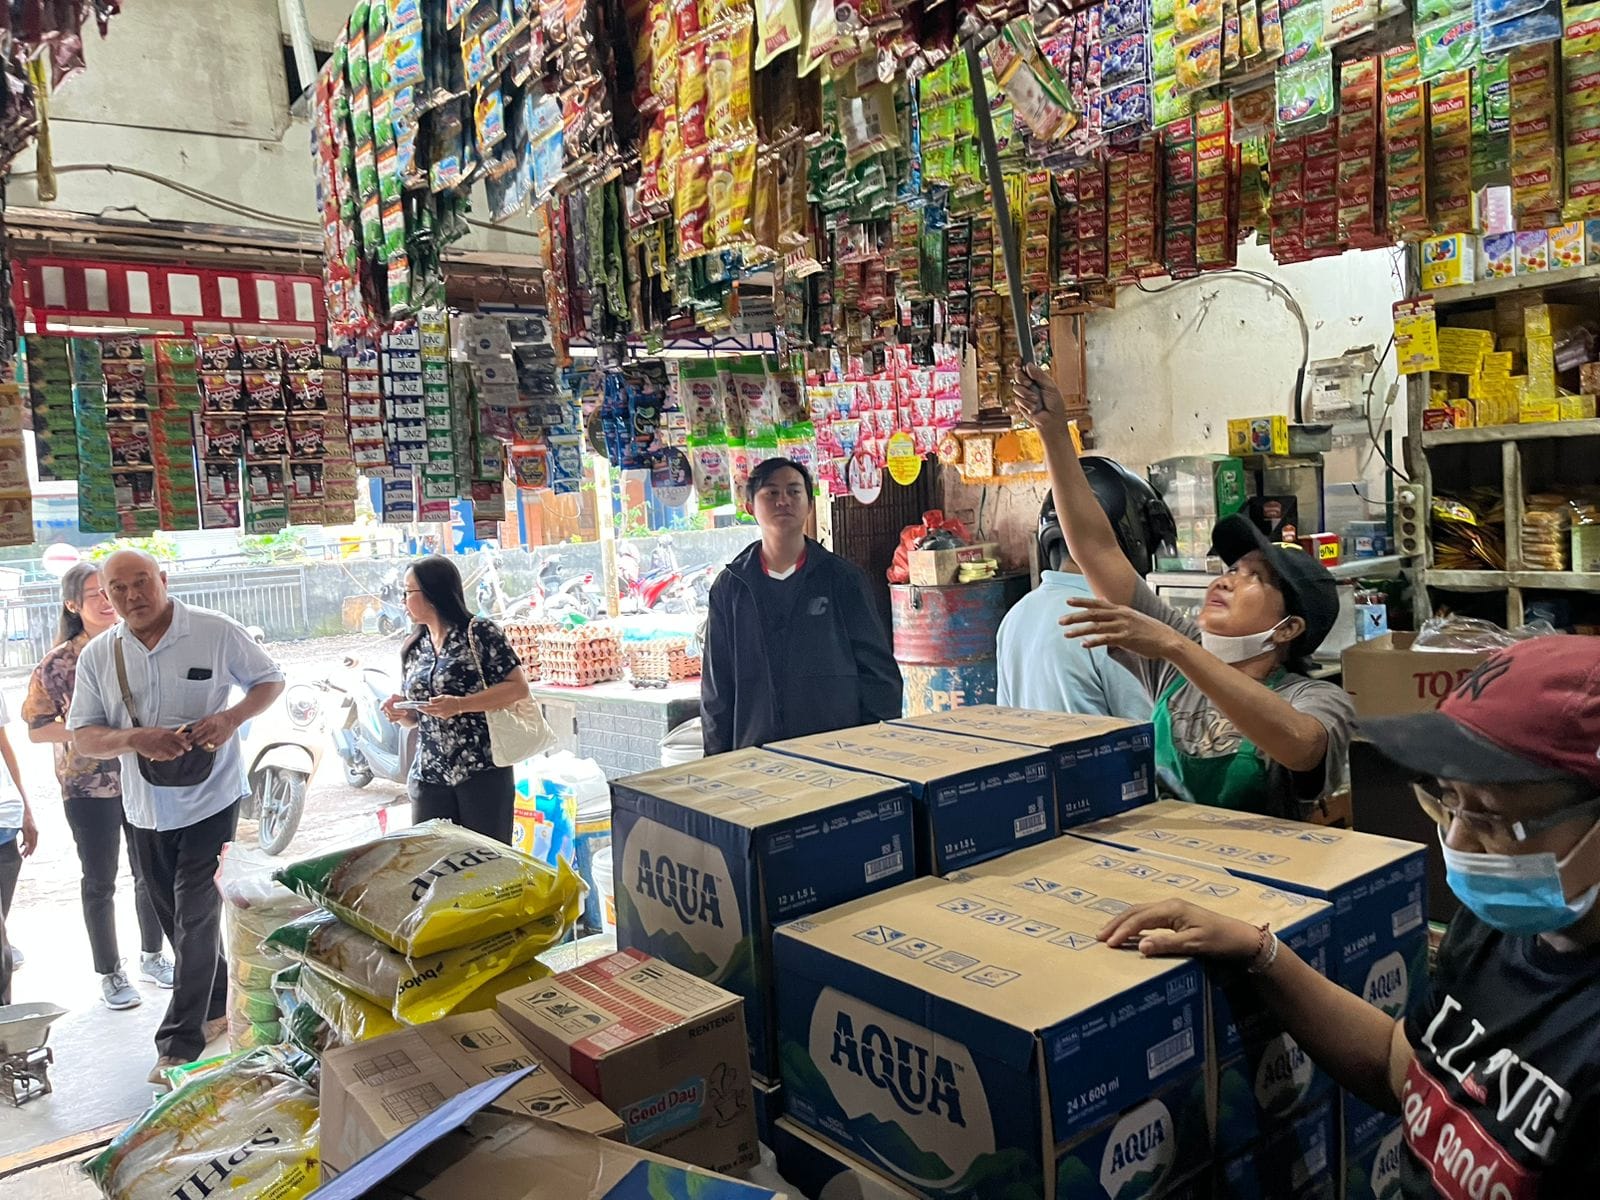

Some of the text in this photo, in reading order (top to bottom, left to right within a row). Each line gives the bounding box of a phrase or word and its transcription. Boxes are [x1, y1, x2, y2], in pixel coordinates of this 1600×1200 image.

[1513, 67, 1546, 83] NutriSari
[1387, 90, 1417, 105] NutriSari
[1432, 99, 1463, 115] NutriSari
[1514, 121, 1548, 136] NutriSari
[1389, 138, 1418, 152] NutriSari
[1514, 173, 1548, 188] NutriSari
[1390, 187, 1420, 201] NutriSari
[422, 313, 440, 321] ZINC
[396, 337, 413, 345] ZINC
[400, 384, 417, 392] ZINC
[402, 407, 419, 415] ZINC
[404, 430, 421, 438] ZINC
[945, 844, 953, 854] 12
[960, 839, 969, 849] 1.5
[409, 847, 502, 902] SPHP
[636, 849, 724, 929] AQUA
[778, 895, 787, 905] 12
[797, 888, 808, 899] 1.5
[1369, 967, 1402, 1001] AQUA
[688, 1012, 736, 1039] RENTENG
[830, 1010, 967, 1128] AQUA
[1264, 1047, 1305, 1088] AQUA
[1067, 1098, 1079, 1115] 24
[1080, 1094, 1087, 1107] X
[1088, 1083, 1108, 1102] 600
[1108, 1077, 1120, 1092] ml
[629, 1097, 666, 1126] Good
[668, 1087, 698, 1109] Day
[1110, 1118, 1165, 1176] AQUA
